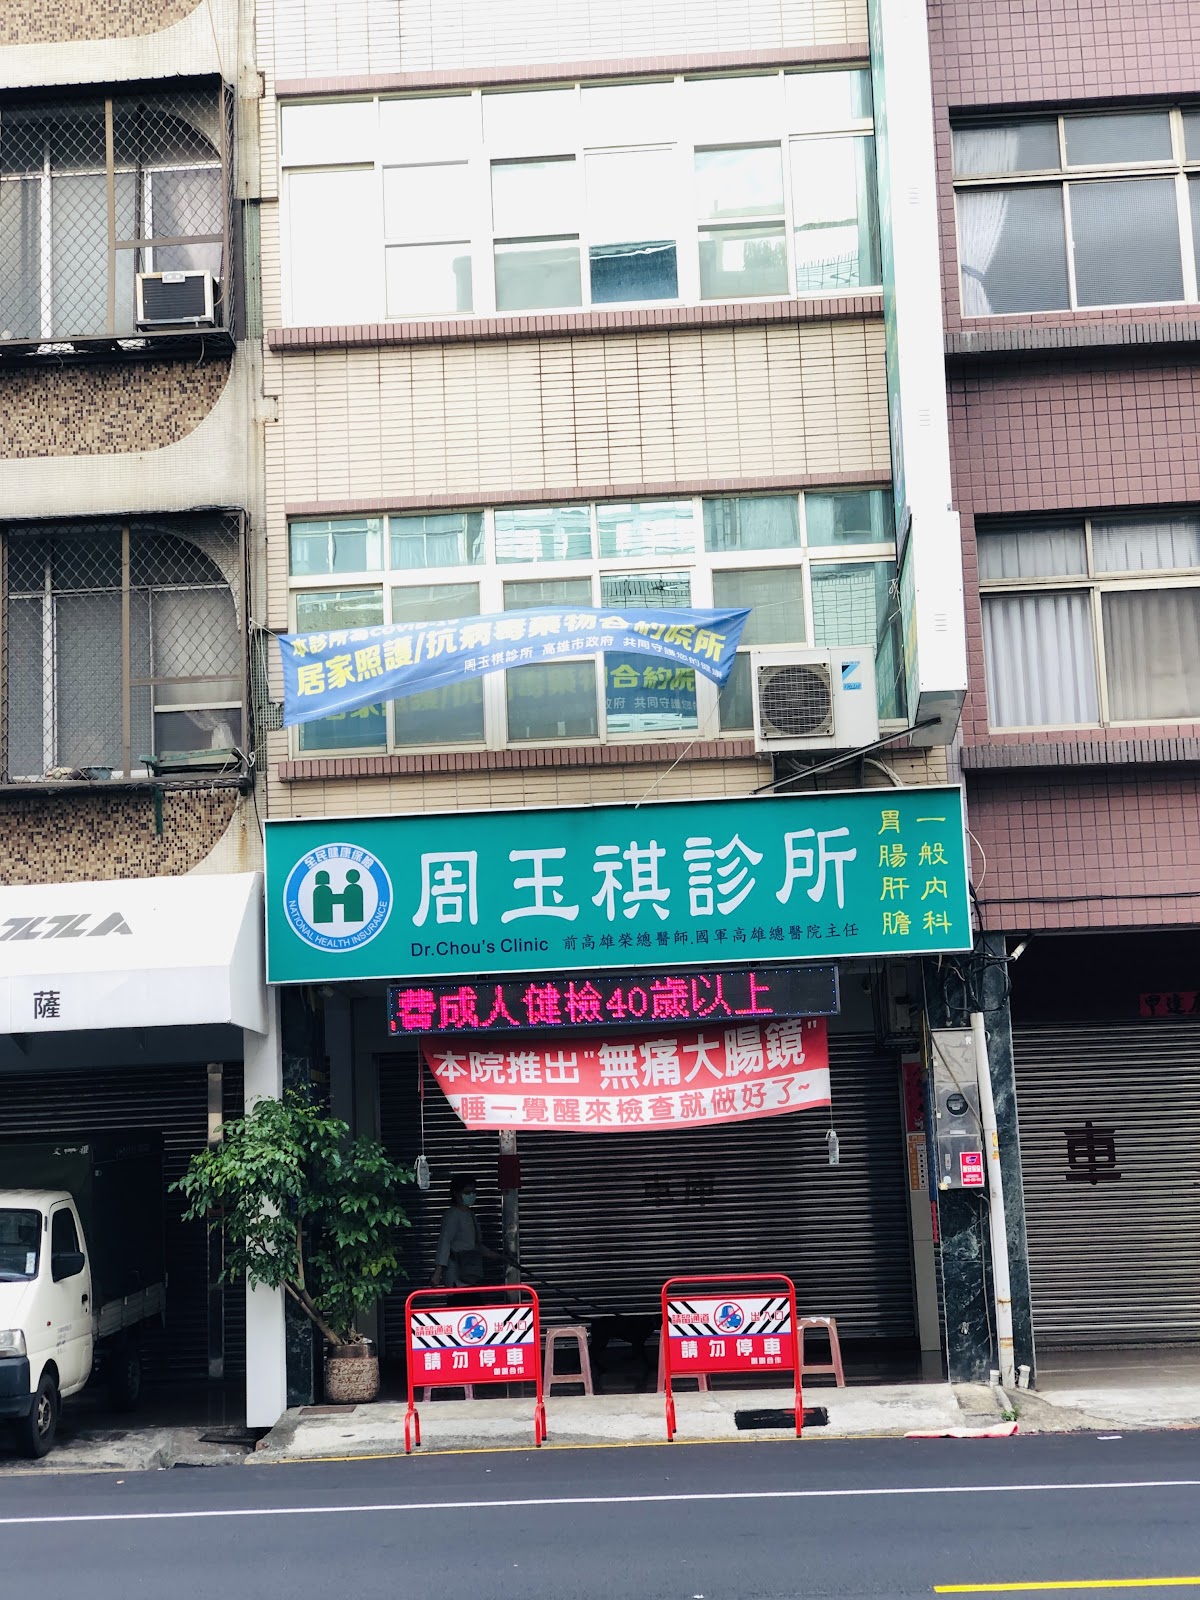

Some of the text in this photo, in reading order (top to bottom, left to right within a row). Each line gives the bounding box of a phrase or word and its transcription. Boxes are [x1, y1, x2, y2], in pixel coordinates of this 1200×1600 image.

[541, 635, 615, 656] 高雄市政府
[304, 846, 375, 870] 全民健康保險
[411, 826, 857, 928] 周玉祺診所
[877, 809, 912, 937] 胃腸肝膽
[915, 815, 953, 936] 一般內科
[288, 899, 388, 948] NATIONAL HEALTH INSURANCE
[499, 937, 549, 953] Clinic
[33, 990, 61, 1020] 薩
[390, 972, 774, 1032] 費成人健檢40歲以上
[494, 1320, 528, 1332] 出入口
[750, 1310, 785, 1322] 出入口
[424, 1347, 524, 1371] 請勿停車
[681, 1338, 782, 1359] 請勿停車
